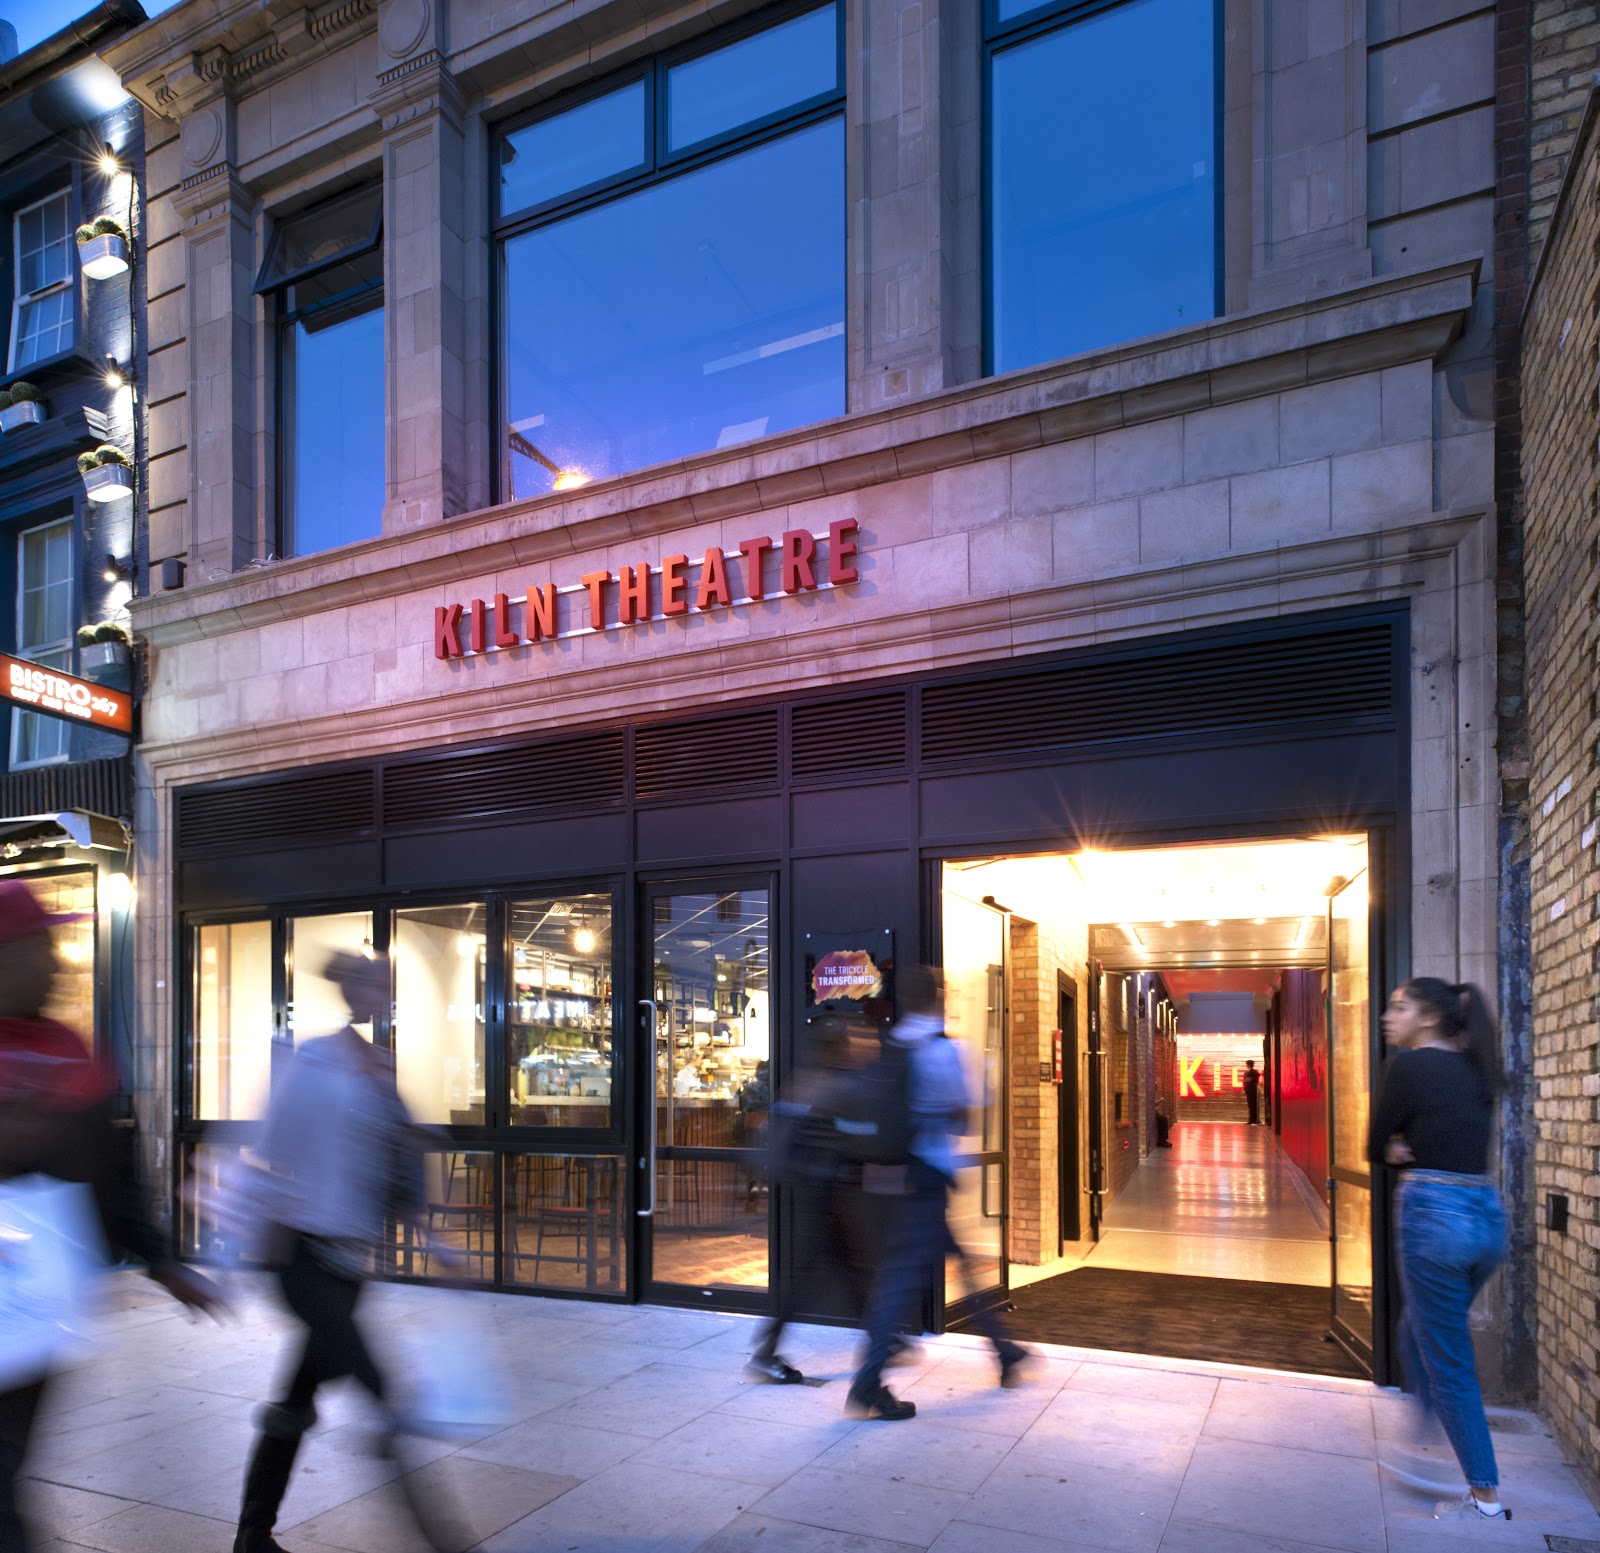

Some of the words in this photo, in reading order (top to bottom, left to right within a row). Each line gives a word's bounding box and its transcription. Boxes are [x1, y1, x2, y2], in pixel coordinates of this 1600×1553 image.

[434, 582, 558, 660] KILN
[581, 517, 859, 630] THEATRE
[10, 664, 91, 706] BISTRO
[91, 696, 118, 716] 267
[818, 976, 874, 986] TRANSFORMED
[824, 967, 837, 975] THE
[838, 965, 868, 975] TRICYCLE
[1180, 1057, 1244, 1097] KIL
